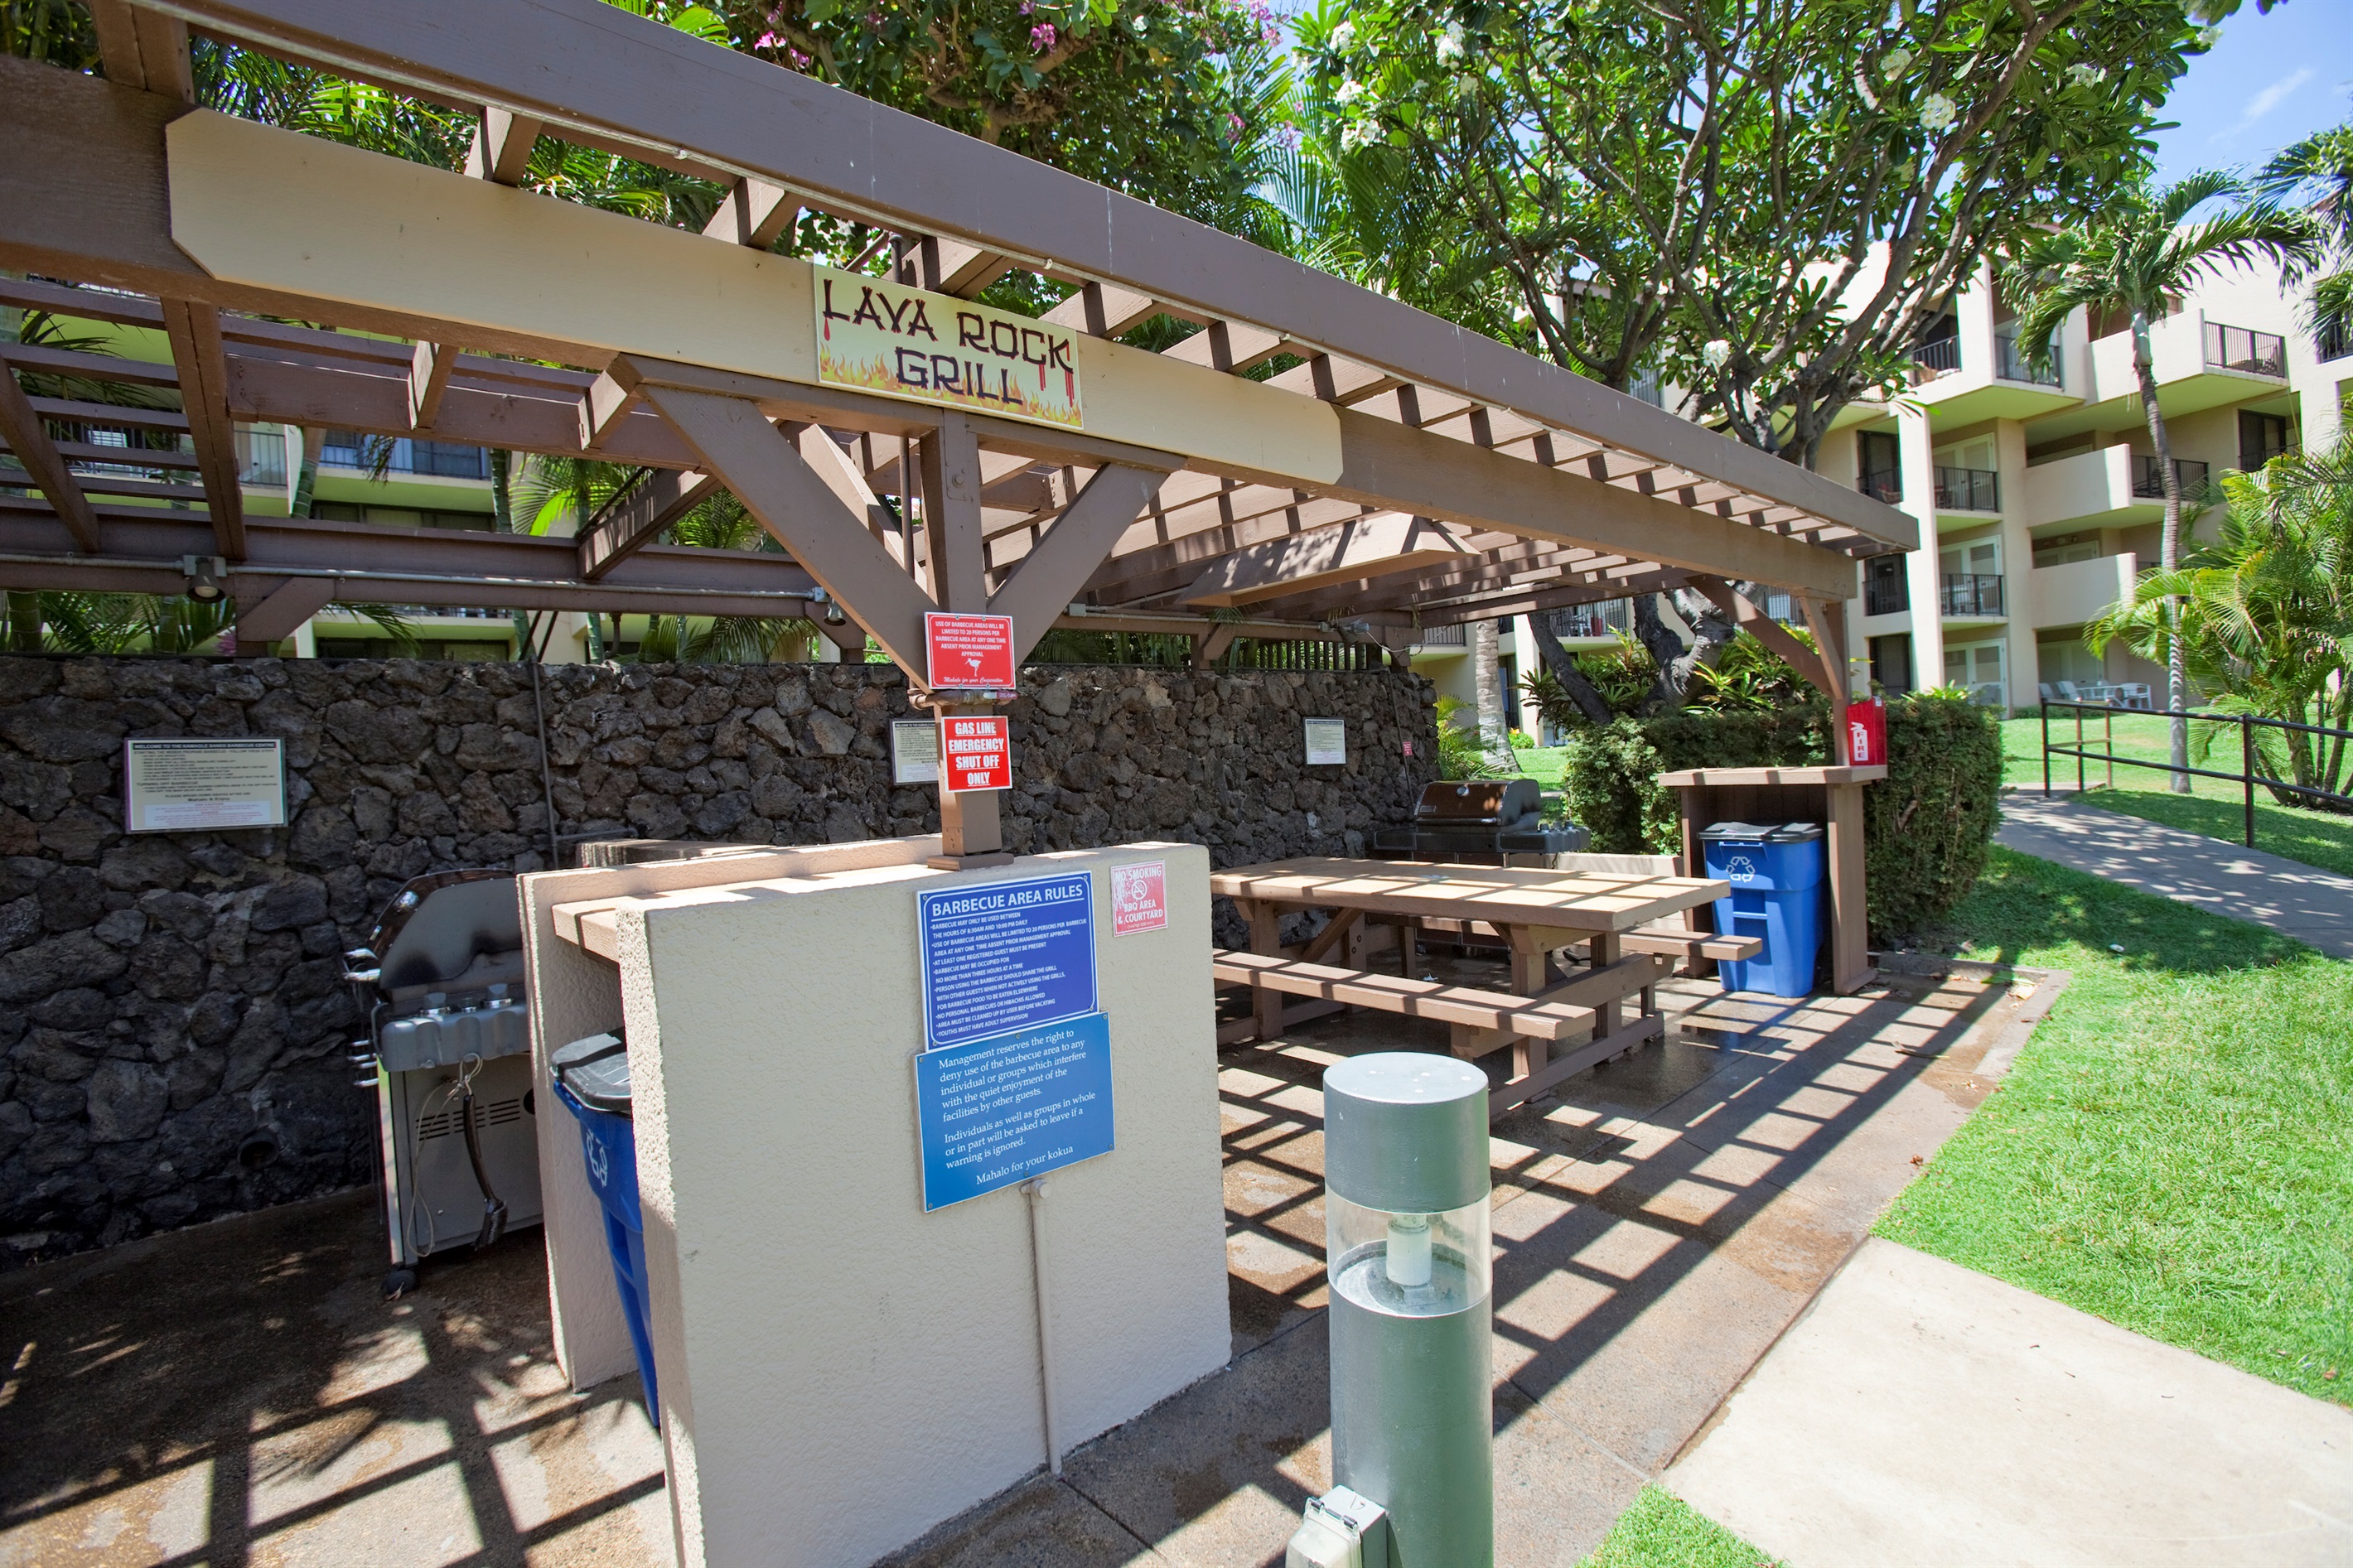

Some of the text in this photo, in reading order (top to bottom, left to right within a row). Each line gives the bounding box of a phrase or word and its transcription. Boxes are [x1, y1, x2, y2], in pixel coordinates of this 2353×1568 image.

[823, 278, 1074, 373] LAVA ROCK
[895, 346, 1023, 405] GRILL
[955, 722, 996, 735] GAS LINE
[949, 739, 1004, 751] EMERGENCY
[1857, 732, 1865, 758] FIRE
[956, 755, 1000, 768] SHUT OFF
[968, 772, 990, 785] ONLY
[1114, 866, 1162, 881] NO SMOKING
[932, 884, 1082, 916] BARBECUE AREA RULES
[1124, 899, 1156, 912] BBQ AREA
[1118, 915, 1123, 924] &
[1124, 909, 1163, 923] COURTYARD
[940, 957, 955, 965] LEAST
[966, 951, 993, 960] REGISTERED
[977, 958, 1000, 967] OCCUPIED
[945, 1008, 969, 1017] PERSONAL
[970, 1002, 996, 1012] BARBECUES
[1003, 996, 1024, 1005] HIBACHIS
[1024, 992, 1045, 1001] ALLOWED
[971, 1011, 993, 1020] CLEANED
[1017, 1003, 1034, 1011] BEFORE
[1034, 998, 1055, 1007] VACATING
[984, 1019, 999, 1027] ADULT
[999, 1013, 1028, 1024] SUPERVISION
[939, 1048, 995, 1069] Management
[996, 1040, 1029, 1054] reserves
[1031, 1036, 1044, 1046] the
[1046, 1031, 1065, 1044] right
[940, 1071, 961, 1082] deny
[964, 1067, 978, 1076] use
[980, 1060, 989, 1072] of
[990, 1059, 1003, 1069] the
[1005, 1050, 1041, 1065] barbecue
[1043, 1046, 1060, 1055] area
[1070, 1040, 1085, 1049] any
[940, 1051, 1086, 1095] individual or groups which interfere
[941, 1068, 1067, 1108] with the quiet enjoyment of the
[943, 1088, 1042, 1122] facilities by other guests.
[945, 1122, 993, 1143] Individuals
[1004, 1111, 1022, 1124] well
[1033, 1102, 1061, 1118] groups
[1063, 1098, 1070, 1107] in
[1072, 1091, 1095, 1104] whole
[945, 1147, 955, 1156] or
[957, 1144, 966, 1153] in
[968, 1136, 985, 1152] part
[987, 1130, 1003, 1143] will
[1003, 1128, 1013, 1137] be
[1015, 1119, 1038, 1134] asked
[1040, 1118, 1048, 1127] to
[1049, 1112, 1070, 1123] leave
[1071, 1107, 1076, 1117] if
[945, 1136, 1026, 1169] warning is ignored.
[976, 1146, 1073, 1184] Mahalo for your kokua
